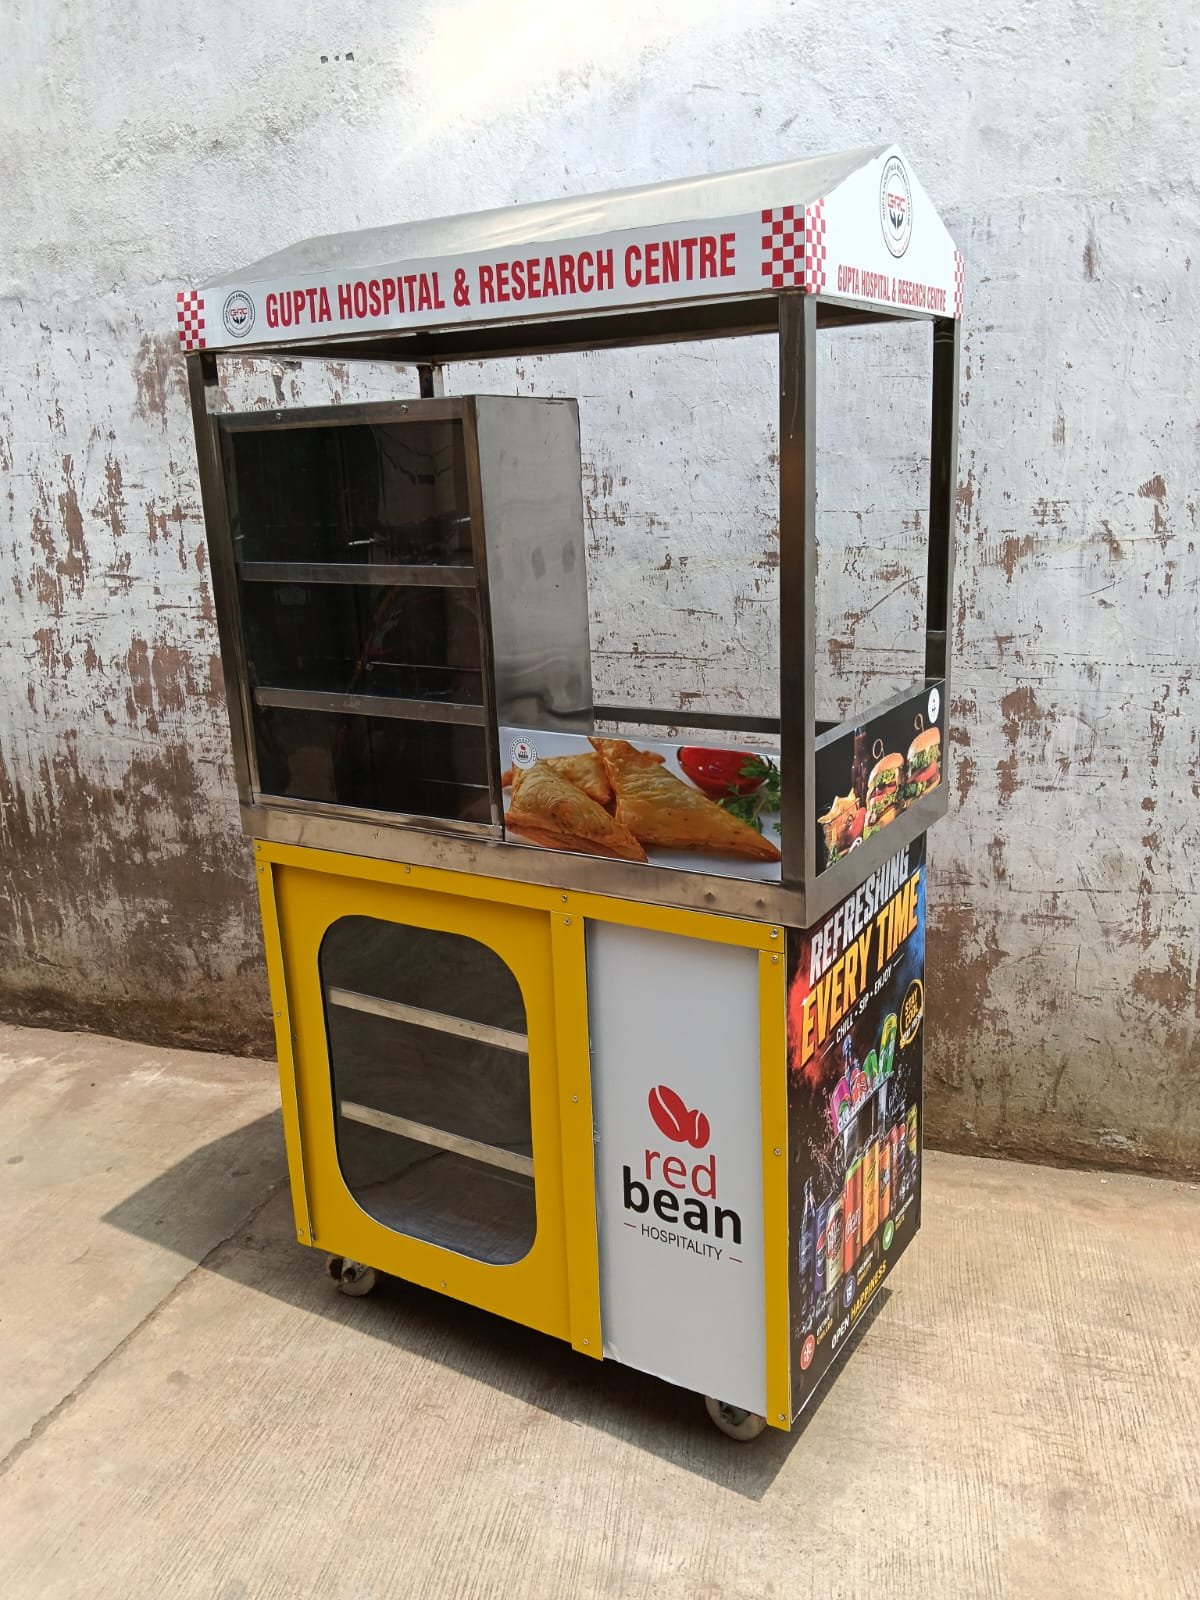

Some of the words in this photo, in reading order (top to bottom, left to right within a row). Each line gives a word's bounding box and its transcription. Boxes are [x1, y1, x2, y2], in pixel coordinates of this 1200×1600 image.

[265, 286, 332, 328] GUPTA
[337, 272, 445, 320] HOSPITAL
[453, 268, 471, 307] &
[478, 249, 614, 304] RESEARCH
[624, 232, 736, 288] CENTRE
[837, 264, 860, 295] GUPTA
[861, 269, 890, 301] HOSPITAL
[892, 278, 897, 302] &
[898, 279, 927, 308] RESEARCH
[927, 286, 946, 312] CENTRE
[809, 843, 910, 988] REFRESHING
[801, 924, 873, 1067] EVERY
[877, 869, 921, 972] TIME
[836, 1013, 853, 1043] CHILL
[859, 993, 869, 1014] SIP
[874, 963, 892, 995] ENJOY
[623, 1165, 742, 1244] bean
[645, 1149, 717, 1199] red
[641, 1223, 723, 1261] HOSPITALITY
[831, 1314, 850, 1349] OPEN
[850, 1259, 887, 1320] HAPPINESS
